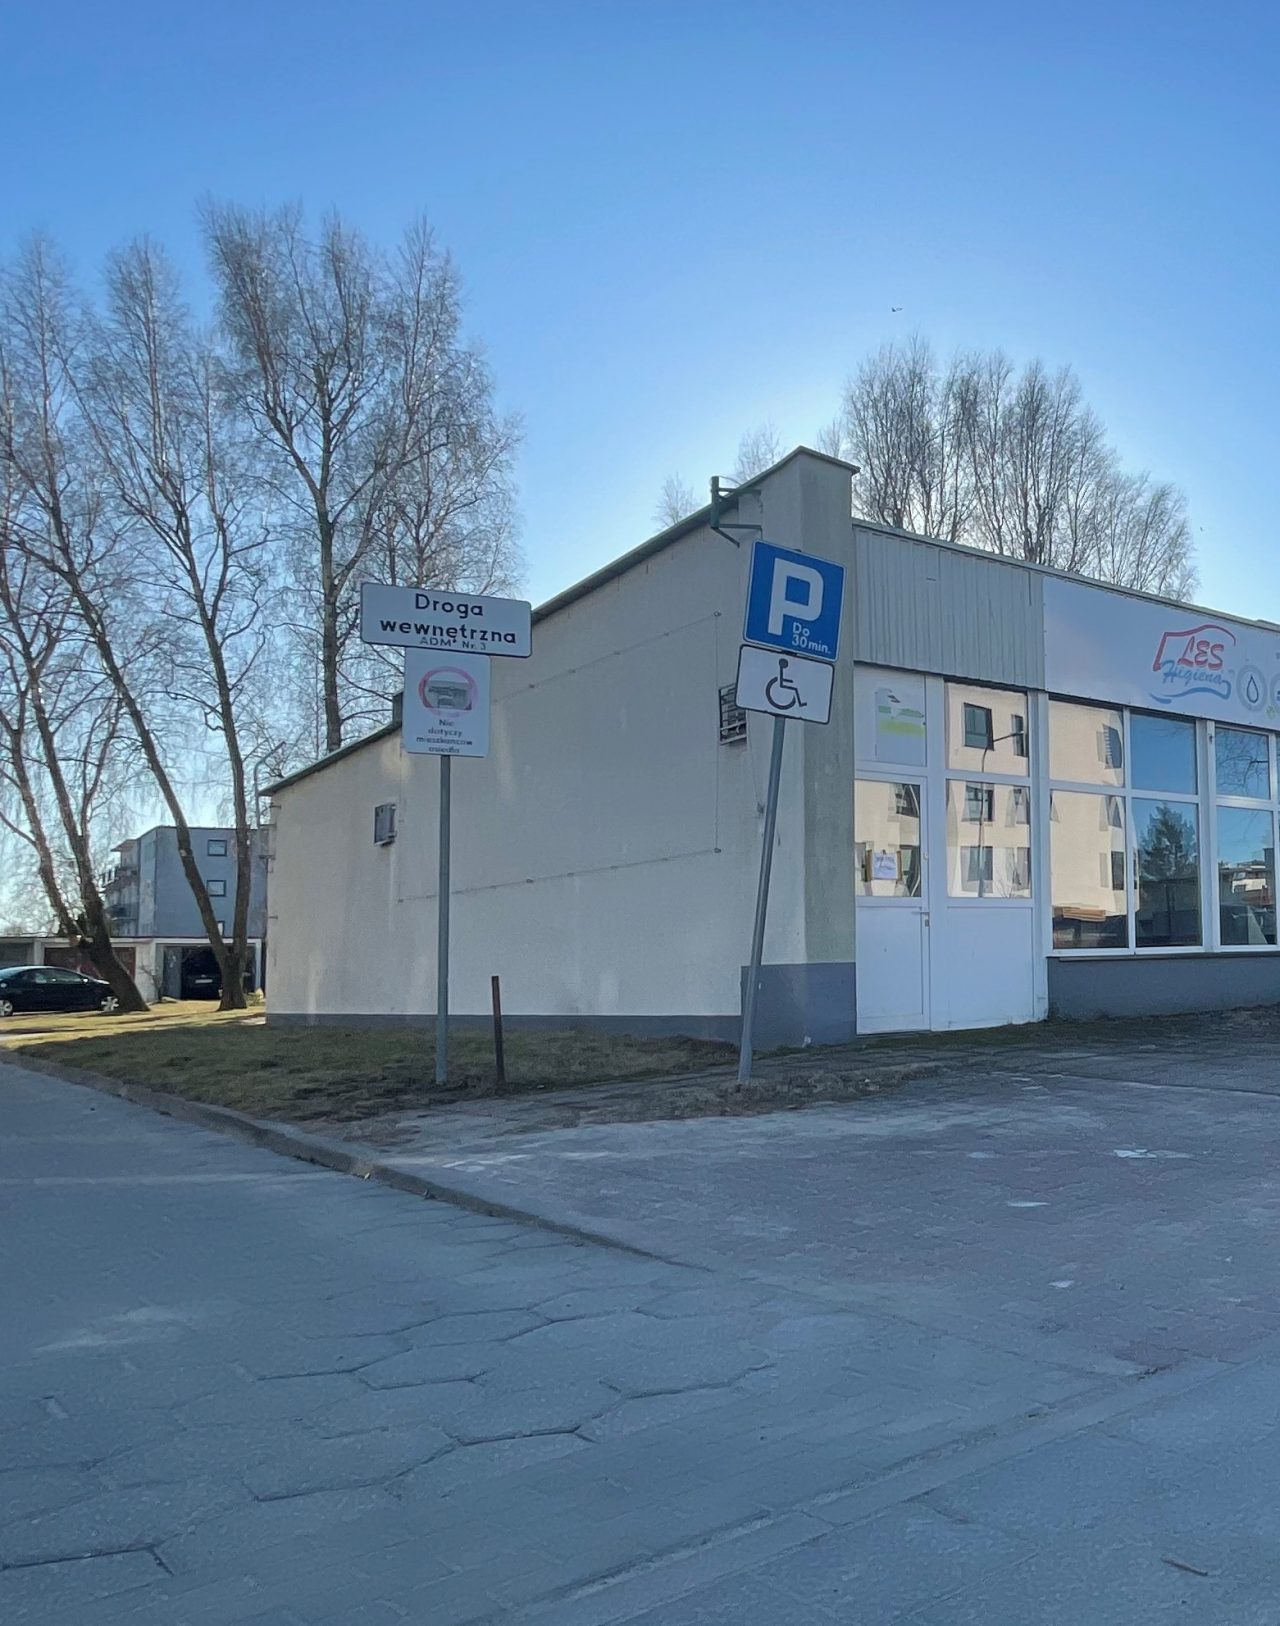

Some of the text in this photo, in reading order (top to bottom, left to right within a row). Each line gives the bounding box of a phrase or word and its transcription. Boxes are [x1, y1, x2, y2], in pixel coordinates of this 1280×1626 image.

[415, 593, 484, 619] Droga
[767, 557, 824, 636] P
[380, 619, 516, 644] wewnętrzna
[792, 622, 811, 637] Do
[1177, 636, 1225, 671] LES
[1160, 659, 1224, 686] Higiena
